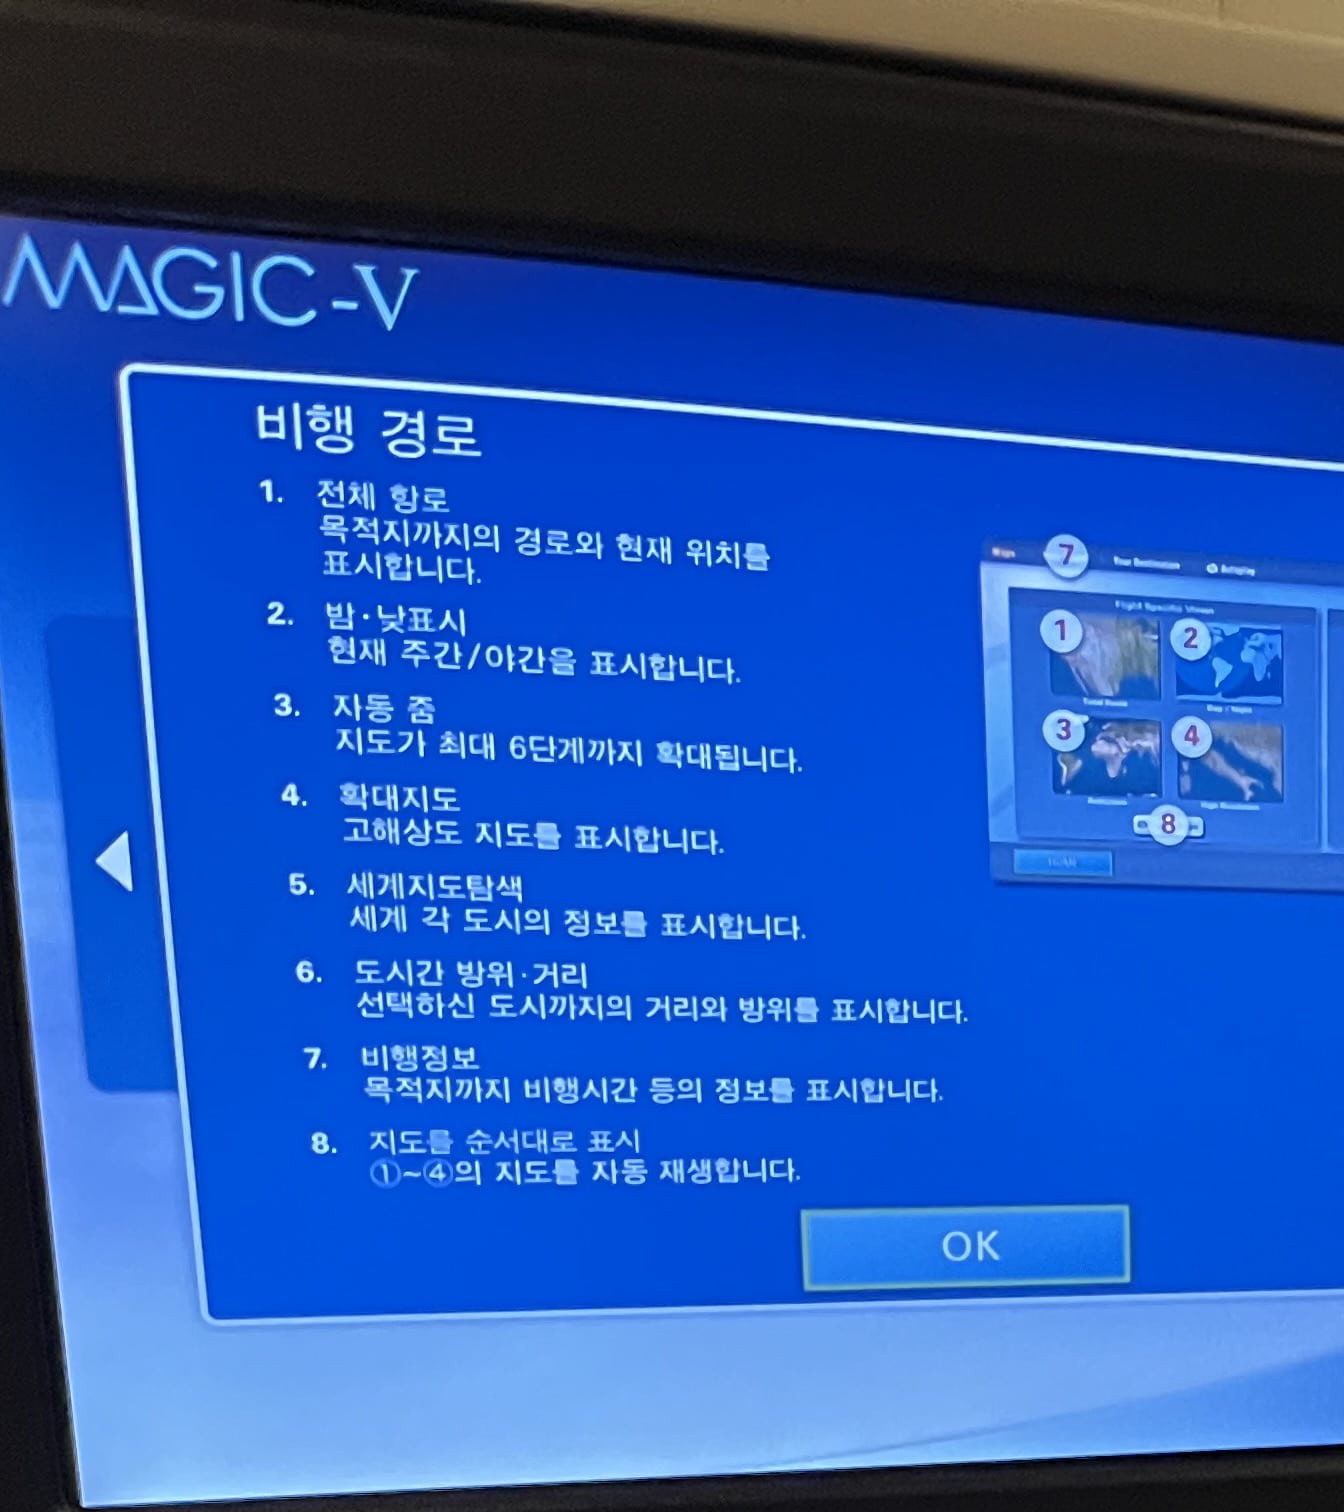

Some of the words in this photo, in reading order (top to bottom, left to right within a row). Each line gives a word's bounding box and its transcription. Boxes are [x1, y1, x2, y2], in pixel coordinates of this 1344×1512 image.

[257, 402, 354, 454] 비행
[381, 410, 482, 459] 경로
[259, 479, 283, 503] 1.
[317, 480, 376, 512] 전체
[389, 484, 450, 514] 항로
[319, 515, 501, 554] 목적지까지의
[514, 527, 603, 560] 경로와
[615, 533, 672, 565] 현재
[686, 539, 771, 572] 위치를
[1058, 543, 1075, 565] 7
[323, 549, 481, 586] 표시합니다.
[267, 601, 294, 626] 2.
[1054, 619, 1067, 641] 1
[1183, 627, 1199, 649] 2
[327, 635, 387, 667] 현재
[401, 639, 577, 676] 주간/야간을
[590, 651, 741, 685] 표시합니다.
[274, 693, 300, 717] 3.
[334, 693, 395, 724] 자동
[1056, 718, 1072, 740] 3
[1183, 725, 1200, 746] 4
[336, 727, 426, 758] 지도가
[439, 730, 496, 761] 최대
[509, 735, 643, 767] 6단계까지
[656, 741, 803, 774] 확대됩니다.
[281, 783, 307, 807] 4.
[339, 782, 461, 813] 확대지도
[343, 817, 463, 847] 고해상도
[475, 820, 562, 850] 지도를
[574, 825, 724, 856] 표시합니다.
[1161, 812, 1177, 835] 8
[289, 872, 315, 896] 5.
[347, 871, 523, 903] 세계지도탐색
[350, 904, 407, 933] 세계
[422, 906, 450, 934] 각
[463, 908, 550, 936] 도시의
[564, 909, 648, 938] 정보를
[661, 913, 806, 941] 표시합니다.
[295, 960, 322, 983] 6.
[355, 959, 444, 987] 도시간
[357, 991, 475, 1019] 선택하신
[489, 993, 632, 1021] 도시까지의
[645, 995, 728, 1023] 거리와
[738, 996, 820, 1024] 방위를
[831, 998, 968, 1025] 표시합니다.
[303, 1047, 327, 1069] 7.
[361, 1044, 480, 1073] 비행정보
[364, 1076, 511, 1104] 목적지까지
[524, 1076, 638, 1105] 비행시간
[649, 1077, 703, 1105] 등의
[715, 1077, 795, 1104] 정보를
[806, 1077, 943, 1104] 표시합니다.
[311, 1131, 337, 1155] 8.
[370, 1129, 454, 1156] 지도를
[466, 1128, 578, 1155] 순서대로
[587, 1128, 640, 1154] 표시
[495, 1158, 579, 1186] 지도를
[592, 1158, 648, 1185] 자동
[659, 1157, 801, 1185] 재생합니다.
[942, 1230, 1000, 1262] OK
